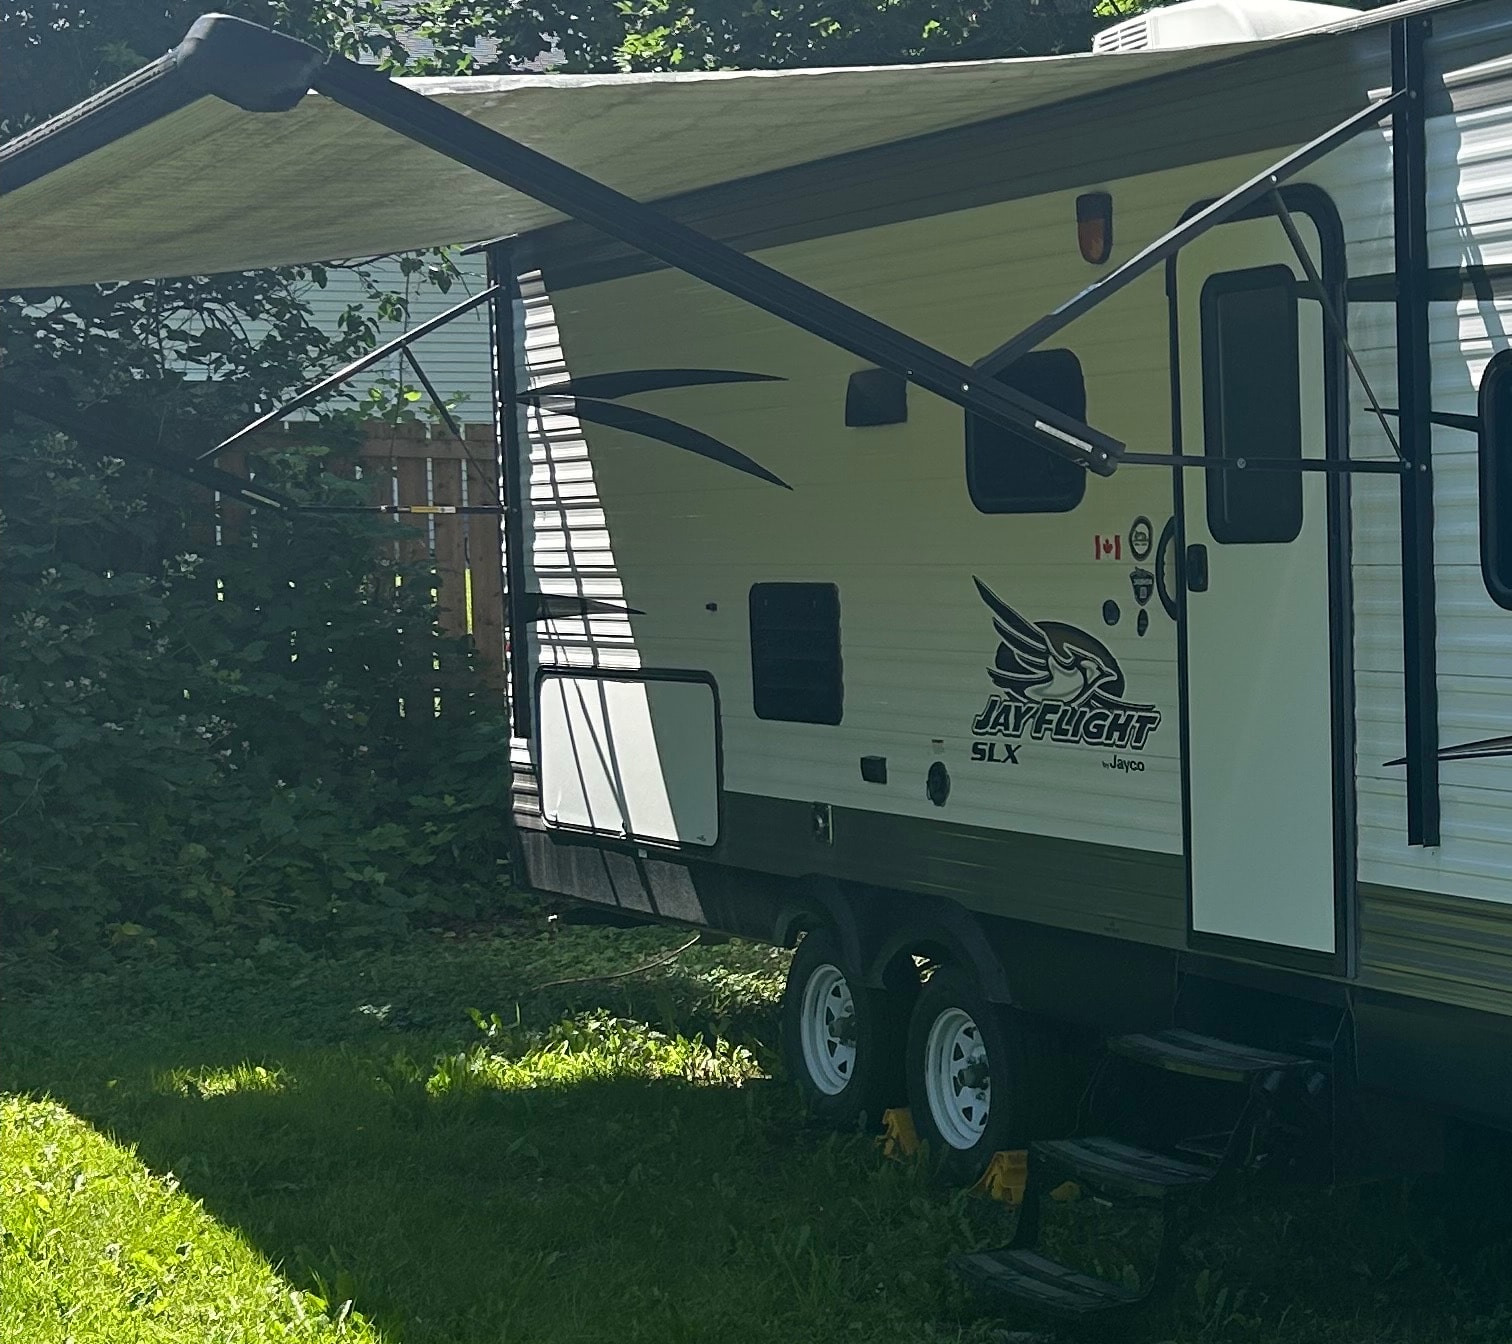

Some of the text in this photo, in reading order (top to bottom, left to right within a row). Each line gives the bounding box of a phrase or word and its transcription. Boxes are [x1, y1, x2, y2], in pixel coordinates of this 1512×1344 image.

[973, 696, 1161, 750] JAY FLIGHT
[971, 742, 1021, 764] SLX
[1110, 754, 1145, 774] Jayco
